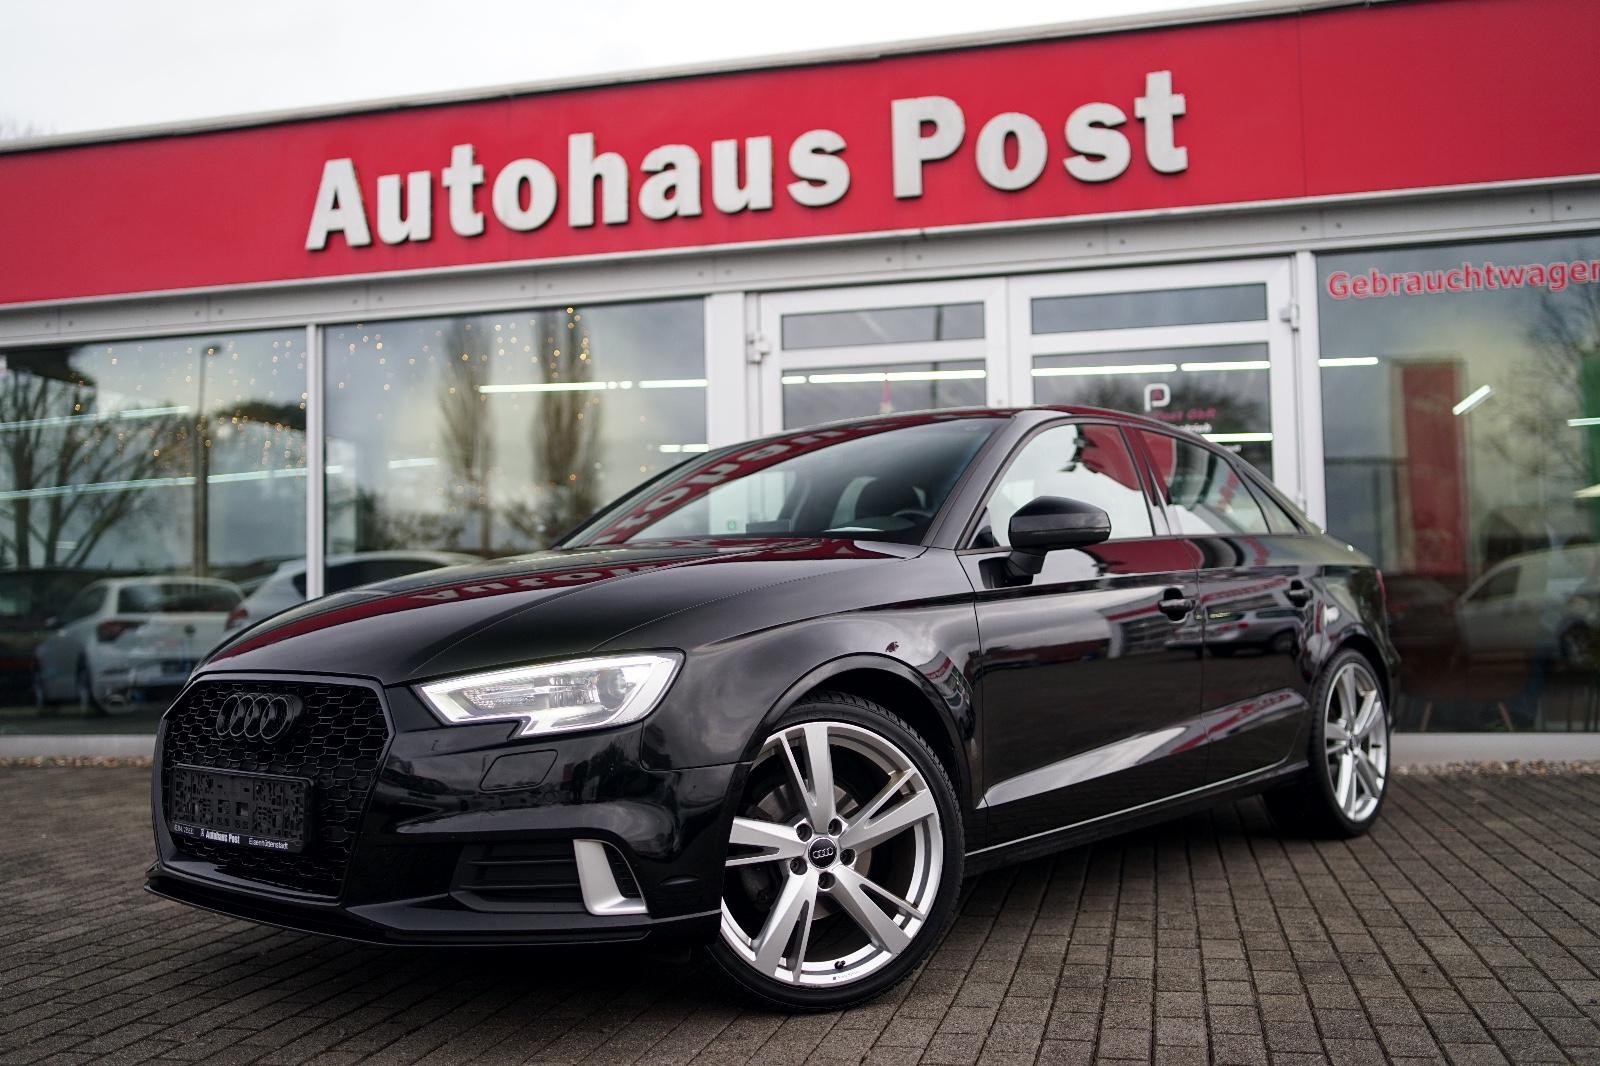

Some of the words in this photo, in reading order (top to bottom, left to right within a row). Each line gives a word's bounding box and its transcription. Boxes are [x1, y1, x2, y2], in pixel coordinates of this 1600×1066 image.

[305, 131, 852, 250] Autohaus
[890, 70, 1188, 198] Post
[229, 833, 240, 844] Post
